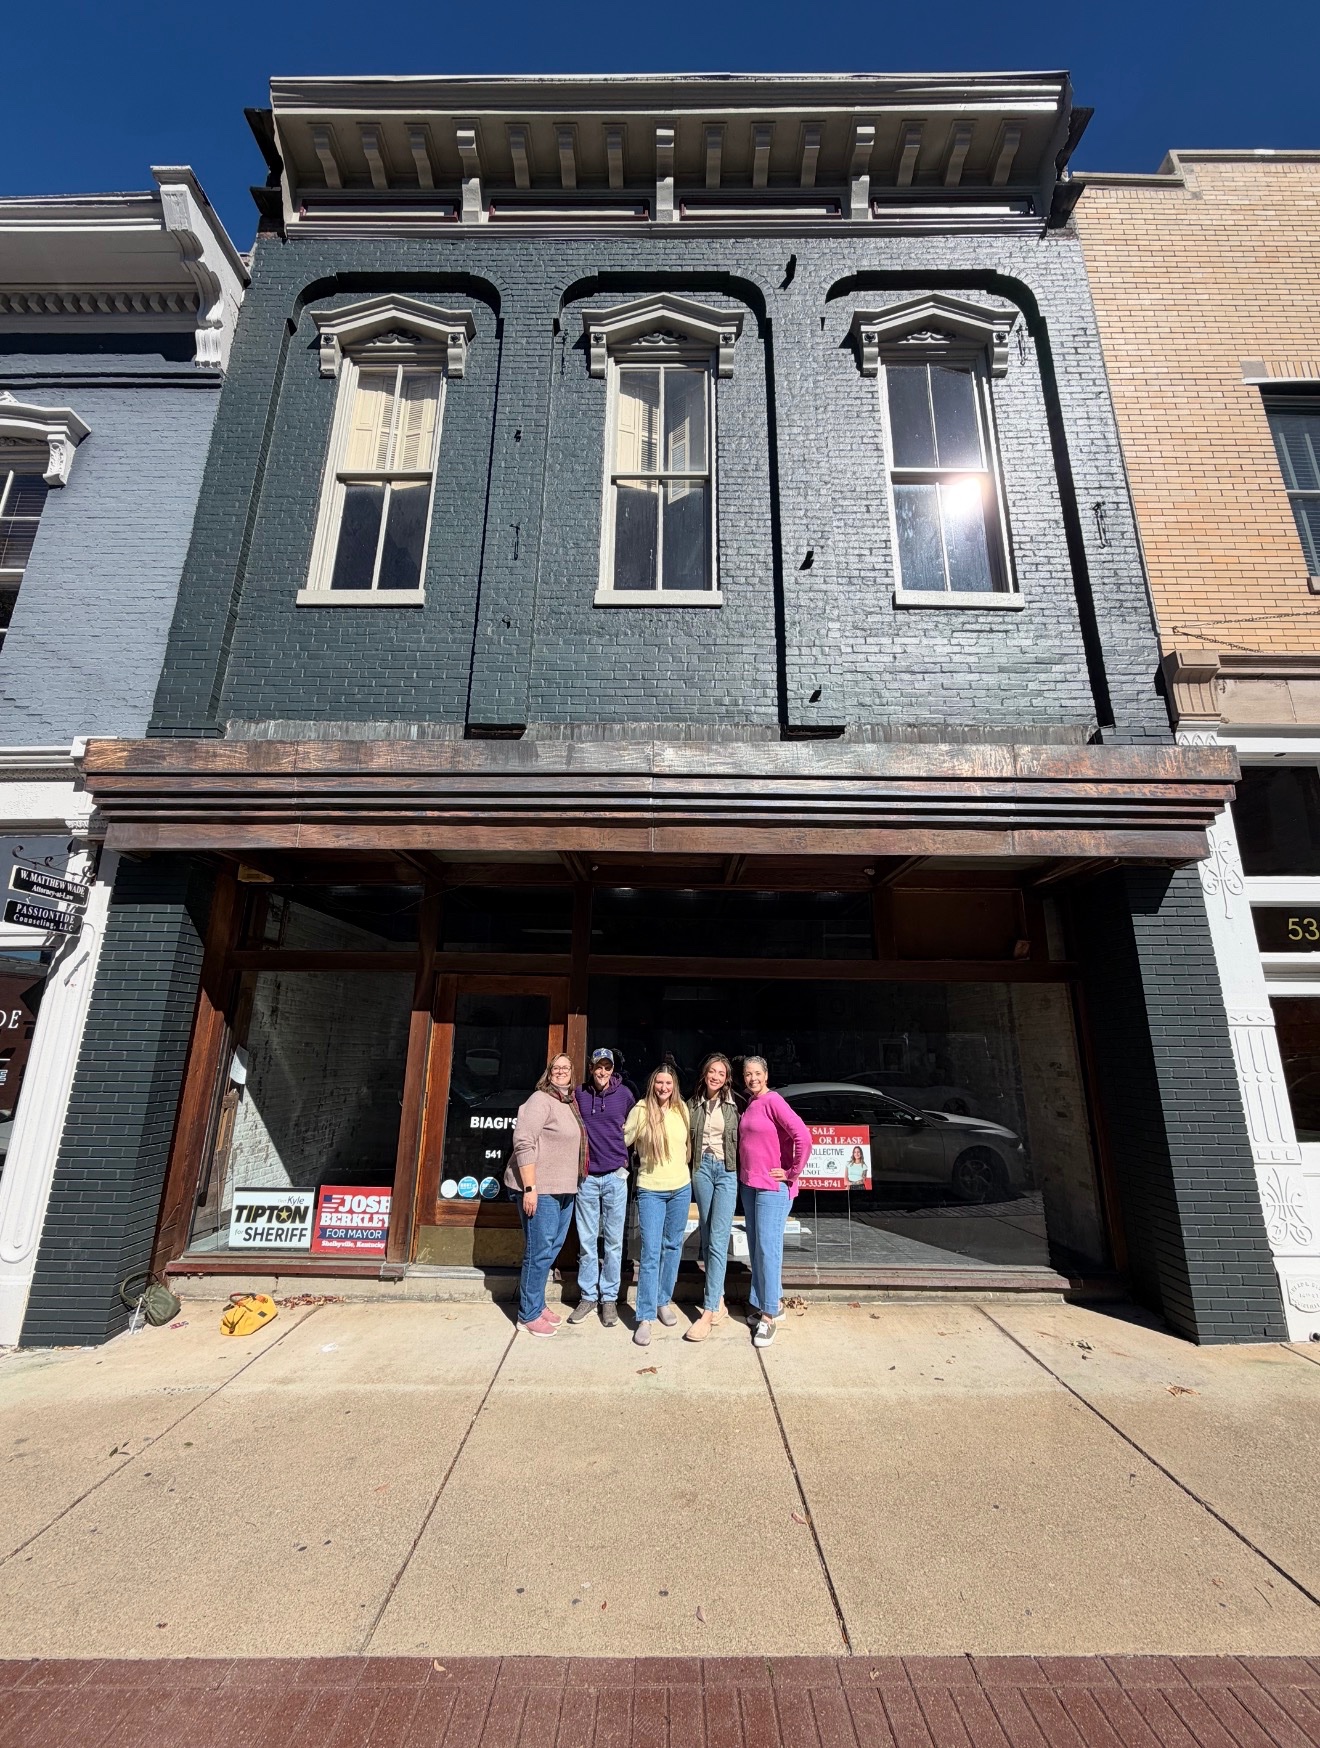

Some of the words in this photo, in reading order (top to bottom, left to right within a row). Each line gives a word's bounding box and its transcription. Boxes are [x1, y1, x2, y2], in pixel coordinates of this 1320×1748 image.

[20, 870, 28, 880] W.
[30, 872, 65, 889] MATTHEW
[67, 881, 85, 895] WADE
[16, 904, 75, 924] PASSIONTIDE
[59, 923, 74, 932] LLC
[812, 1127, 835, 1135] SALE
[485, 1150, 501, 1158] 541
[811, 1148, 844, 1156] OLLECTIVE
[287, 1196, 305, 1206] Kyle
[234, 1205, 310, 1224] TIPTON
[243, 1227, 308, 1242] SHERIFF
[326, 1229, 345, 1238] FOR
[348, 1230, 382, 1238] MAYOR
